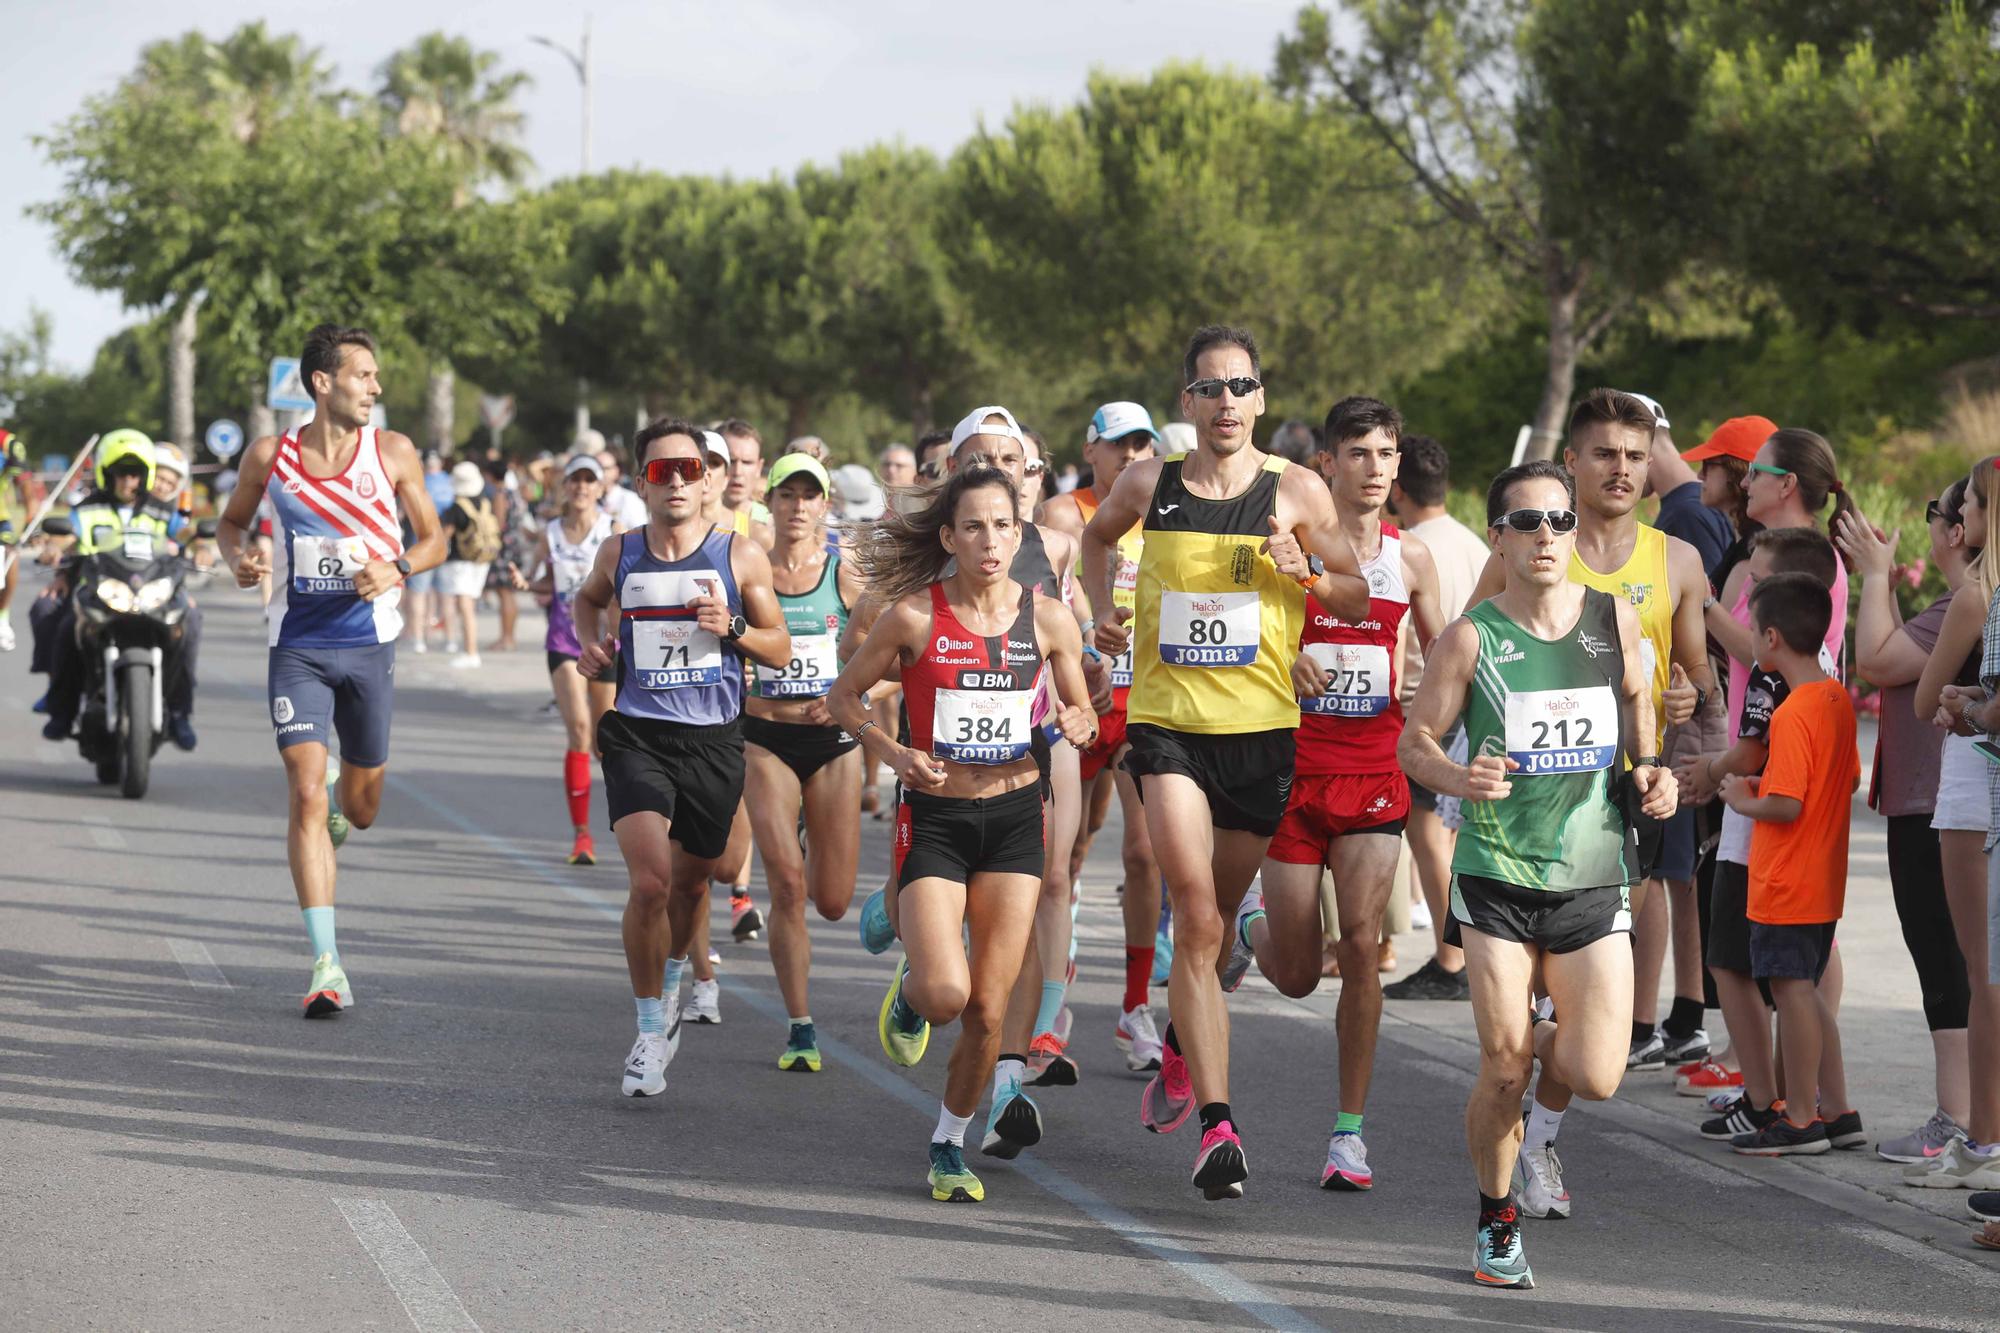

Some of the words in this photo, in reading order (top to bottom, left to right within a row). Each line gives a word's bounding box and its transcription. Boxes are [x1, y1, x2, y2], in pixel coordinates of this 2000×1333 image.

[318, 557, 345, 577] 62
[1189, 619, 1227, 645] 80
[1314, 615, 1339, 628] Caja
[1354, 620, 1382, 630] oria
[936, 636, 974, 653] Bilbao
[659, 645, 689, 668] 71
[936, 656, 980, 665] Guedan
[1494, 651, 1526, 664] VIATOR
[982, 674, 1012, 688] BM
[1324, 668, 1371, 695] 275
[955, 717, 1012, 743] 384
[1531, 717, 1594, 749] 212
